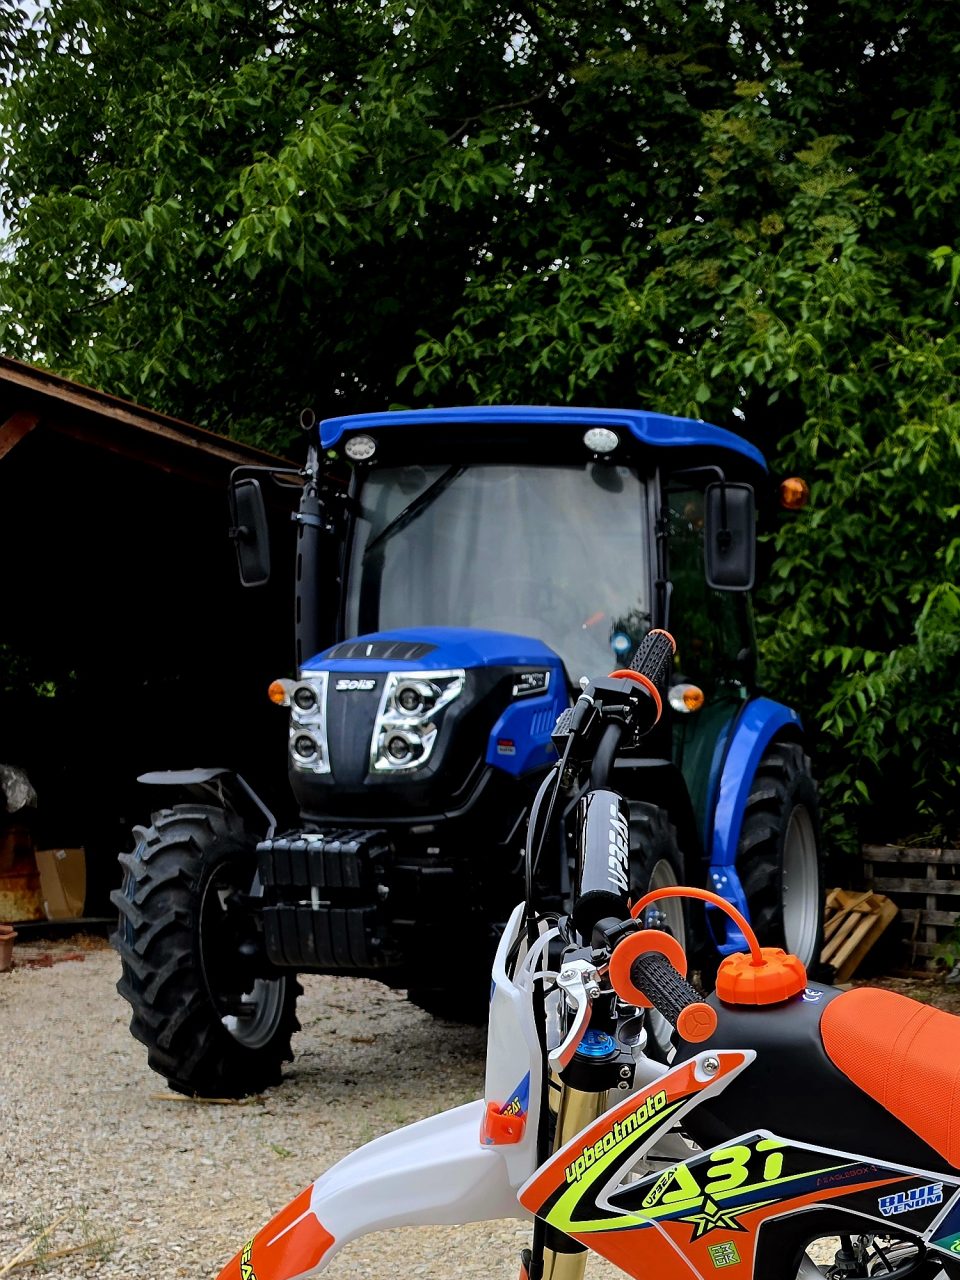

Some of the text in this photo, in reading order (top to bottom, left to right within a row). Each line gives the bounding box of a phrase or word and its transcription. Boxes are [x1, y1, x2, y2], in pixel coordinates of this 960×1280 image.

[565, 1090, 667, 1184] upbeatmoto
[879, 1183, 943, 1208] BLUE
[881, 1194, 943, 1216] VENOM
